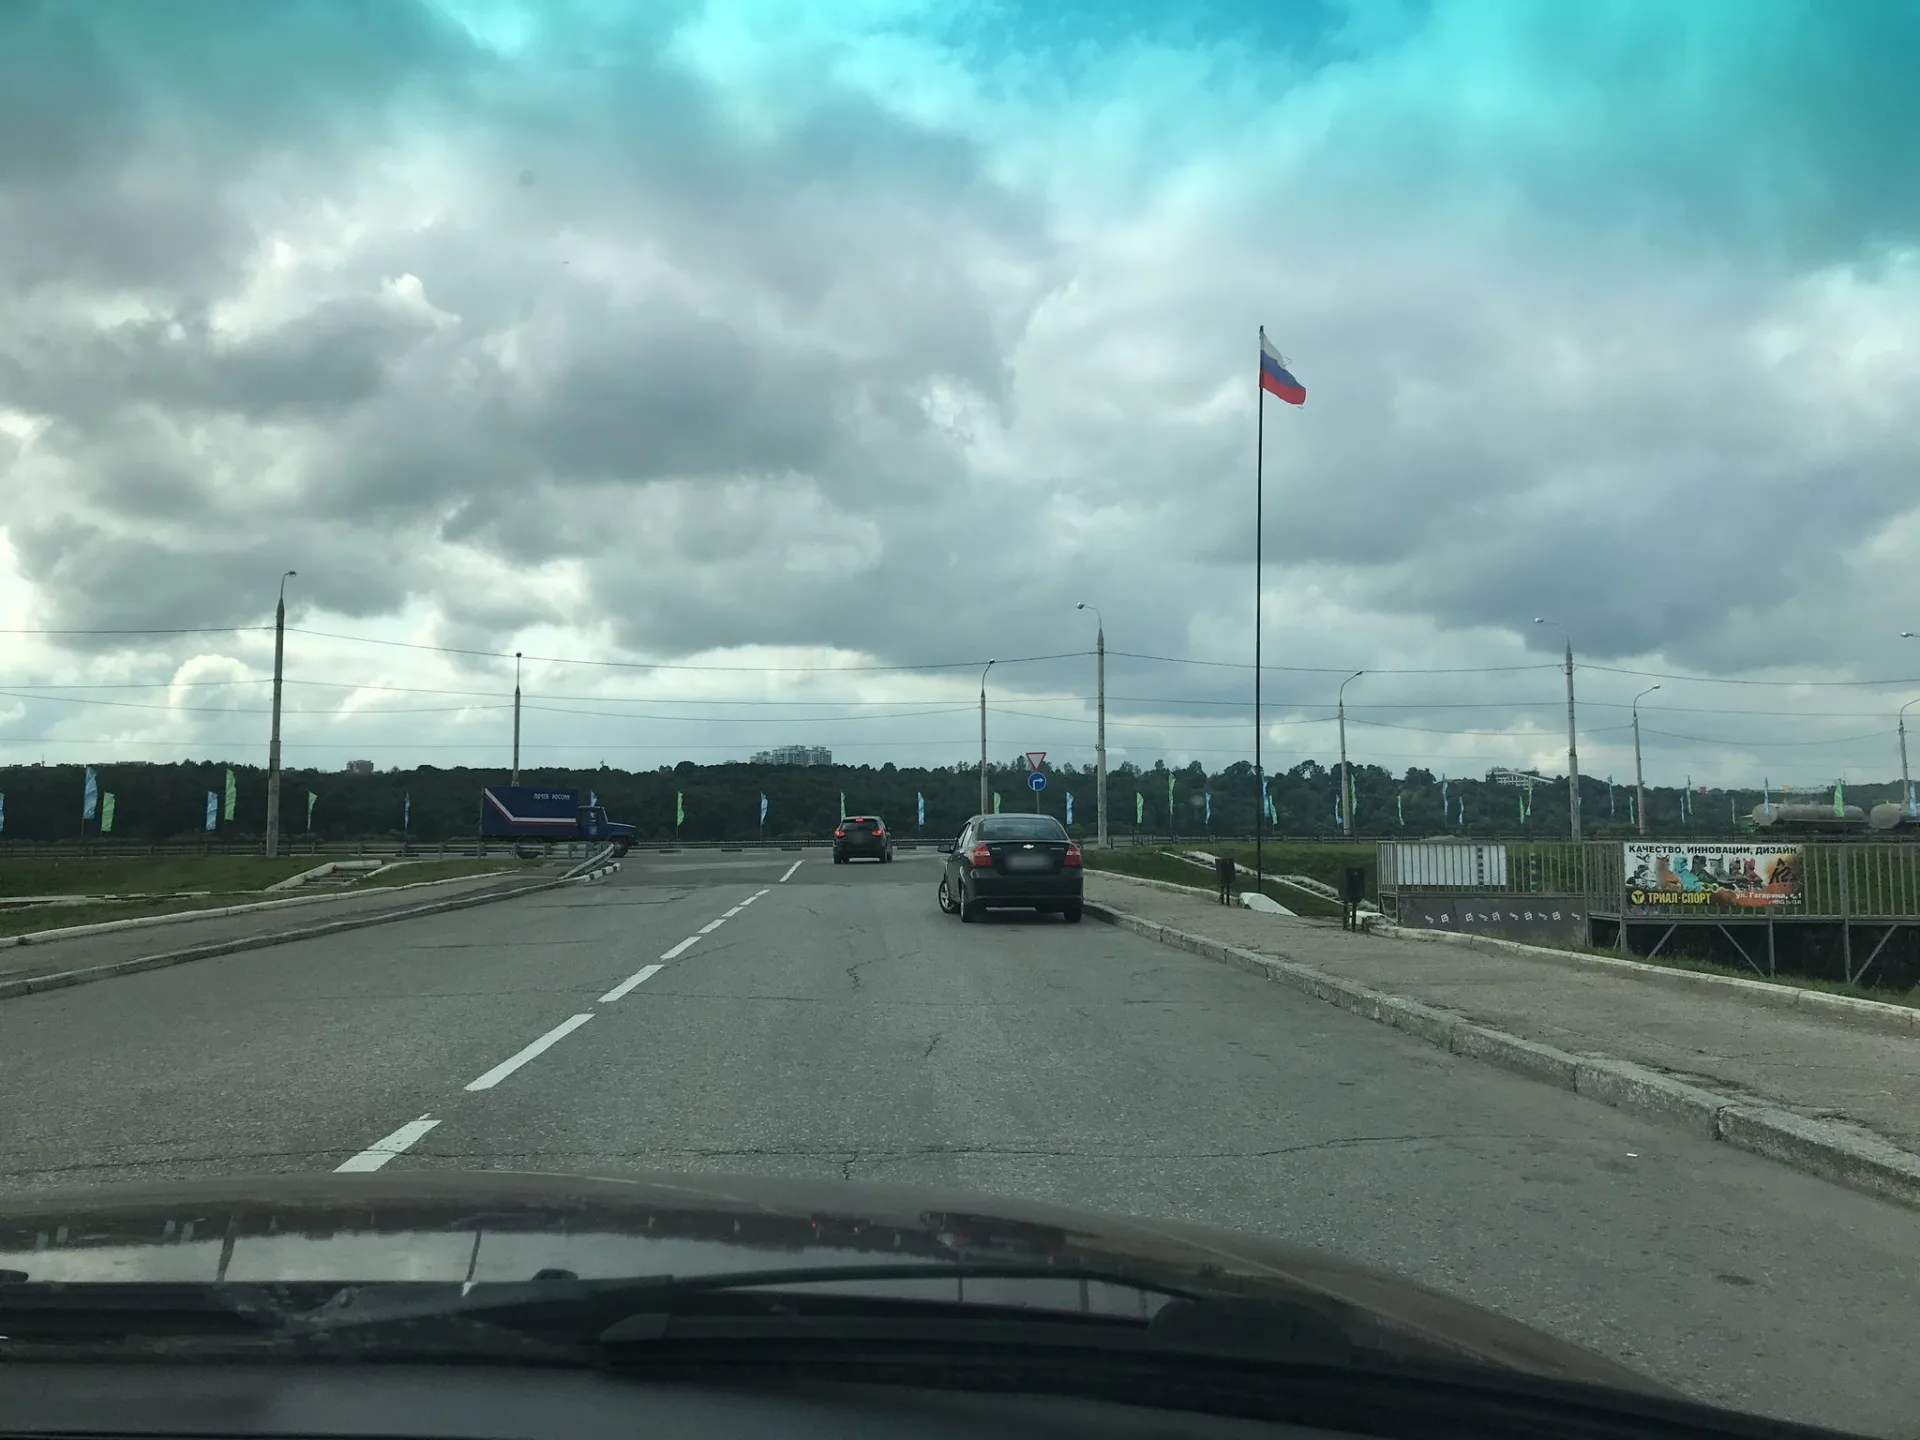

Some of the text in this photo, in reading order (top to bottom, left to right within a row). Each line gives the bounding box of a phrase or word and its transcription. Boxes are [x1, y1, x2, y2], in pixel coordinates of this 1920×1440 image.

[1628, 845, 1797, 856] КАЧЕСТВО, ИННОВАЦИИ, ДИЗАЙН
